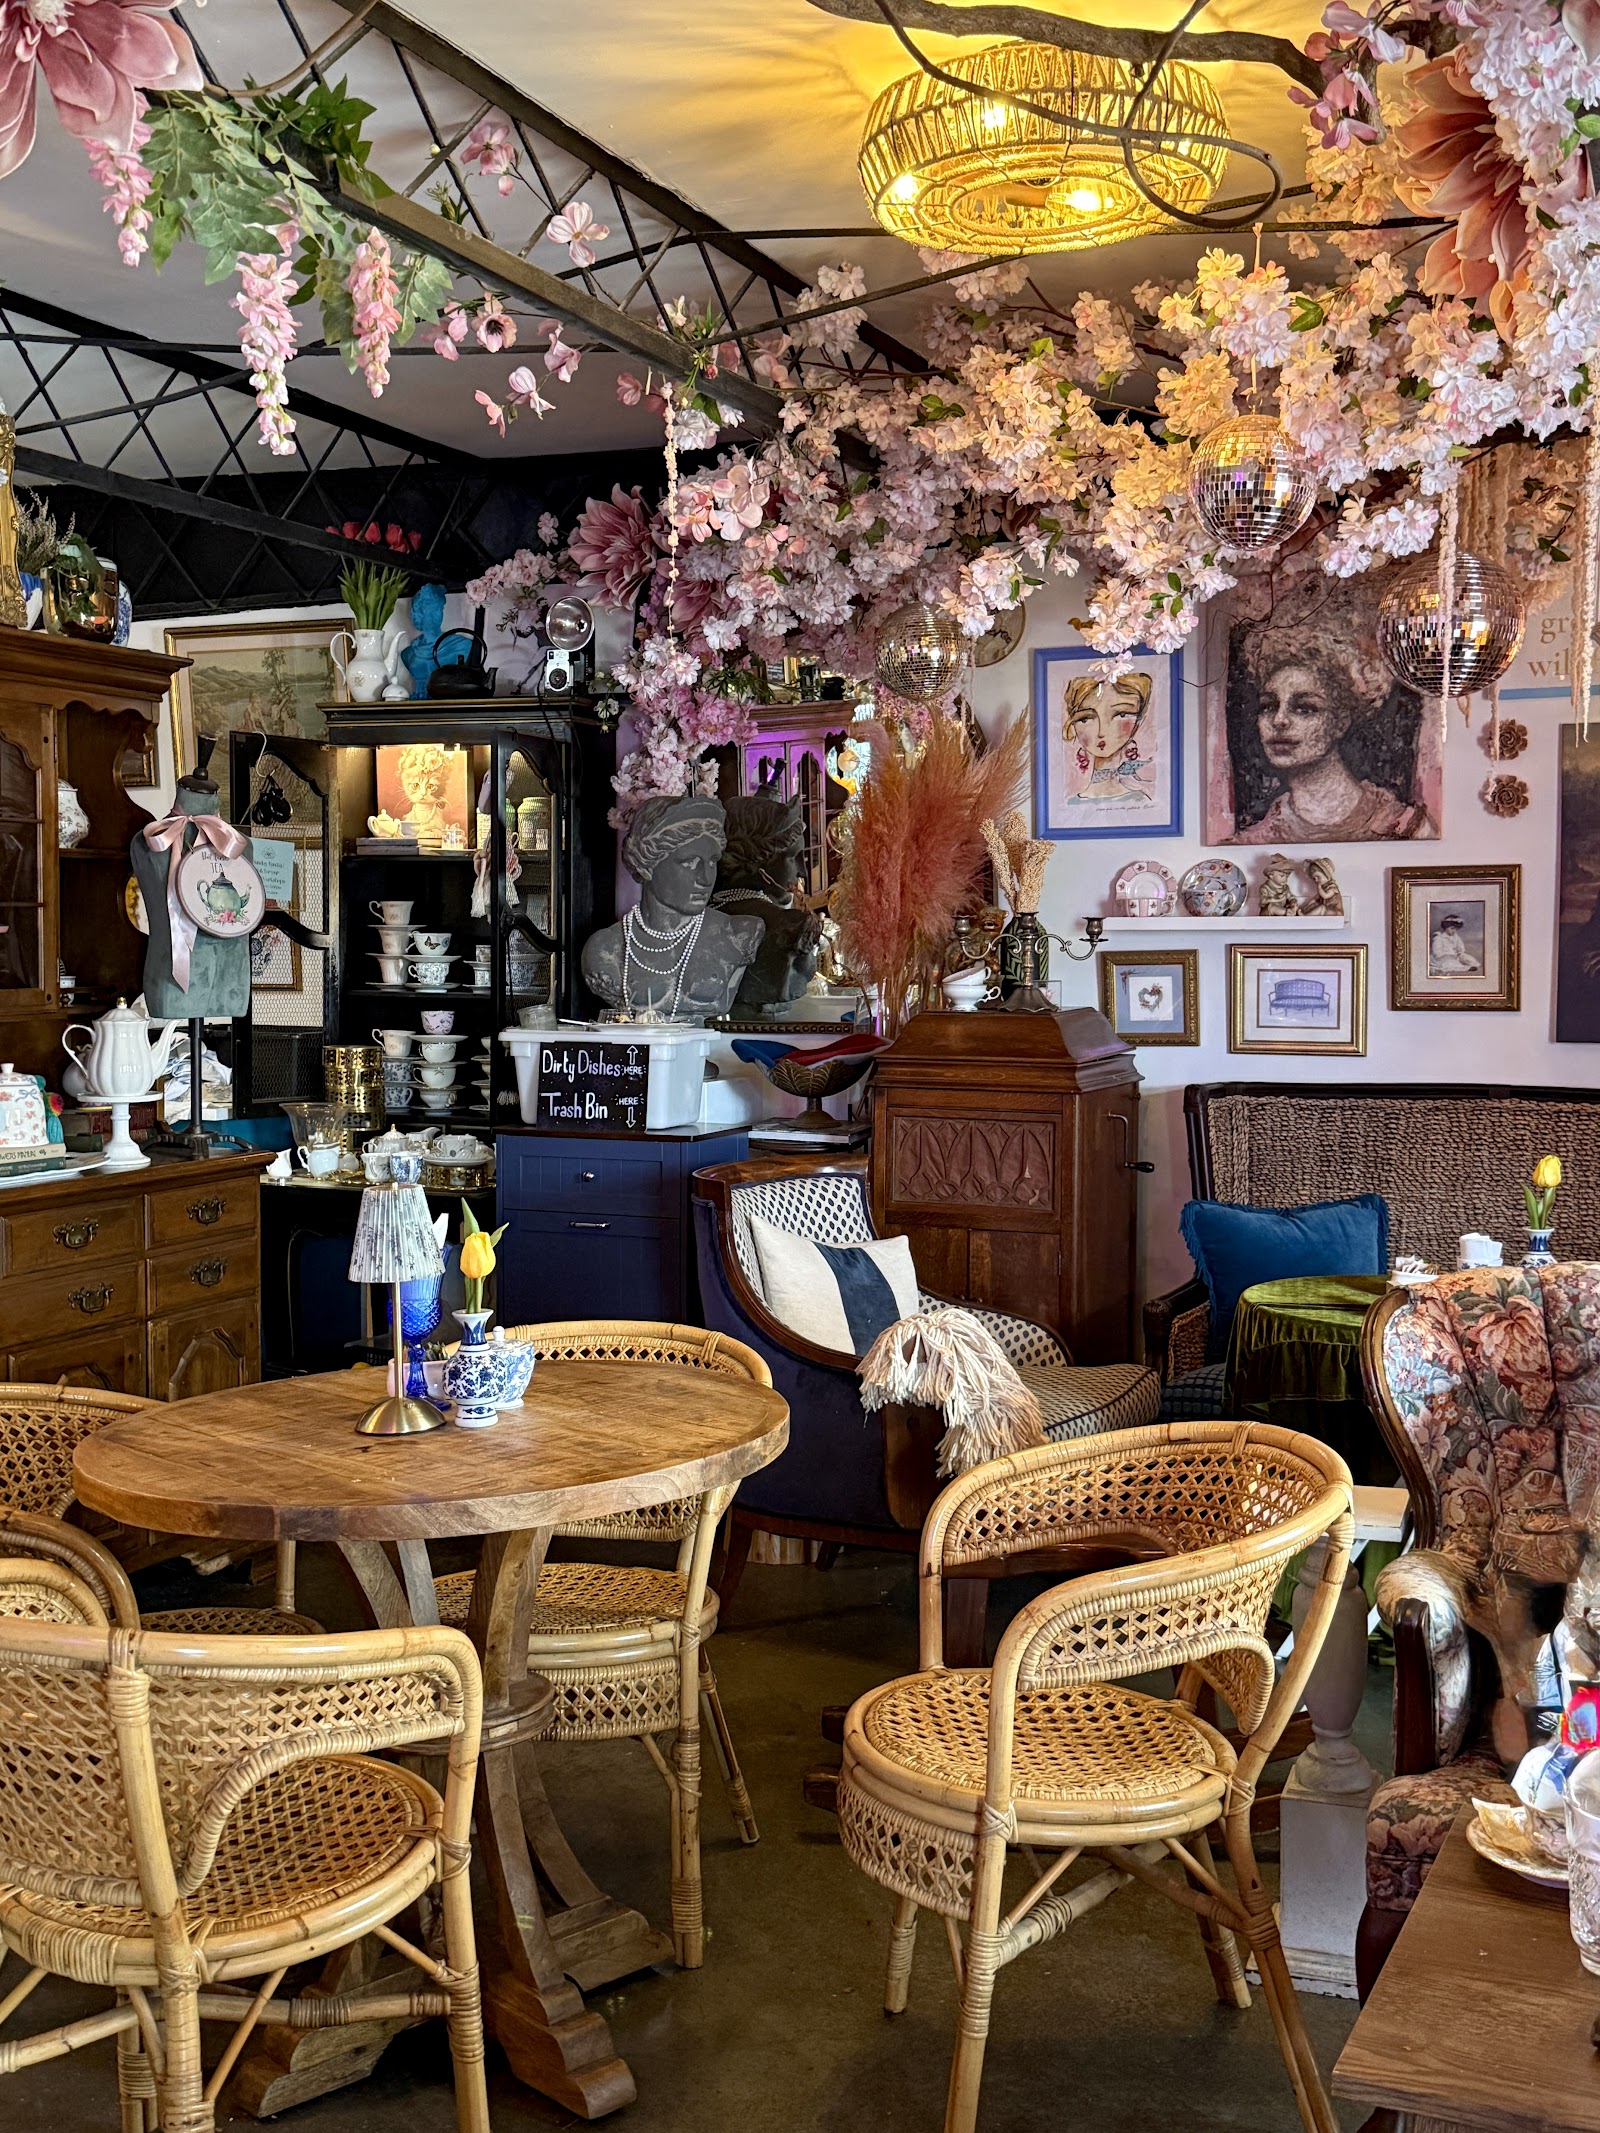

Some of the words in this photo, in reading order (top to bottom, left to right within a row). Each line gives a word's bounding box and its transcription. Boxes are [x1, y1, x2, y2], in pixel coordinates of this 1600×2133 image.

[1540, 617, 1570, 644] gr
[1527, 647, 1570, 677] wil
[210, 862, 224, 873] TEA
[542, 1049, 575, 1083] Dirty
[578, 1049, 621, 1077] Dishes
[623, 1066, 643, 1075] HERE
[540, 1092, 582, 1119] Trash
[585, 1092, 608, 1119] Bin
[618, 1097, 639, 1106] HERE
